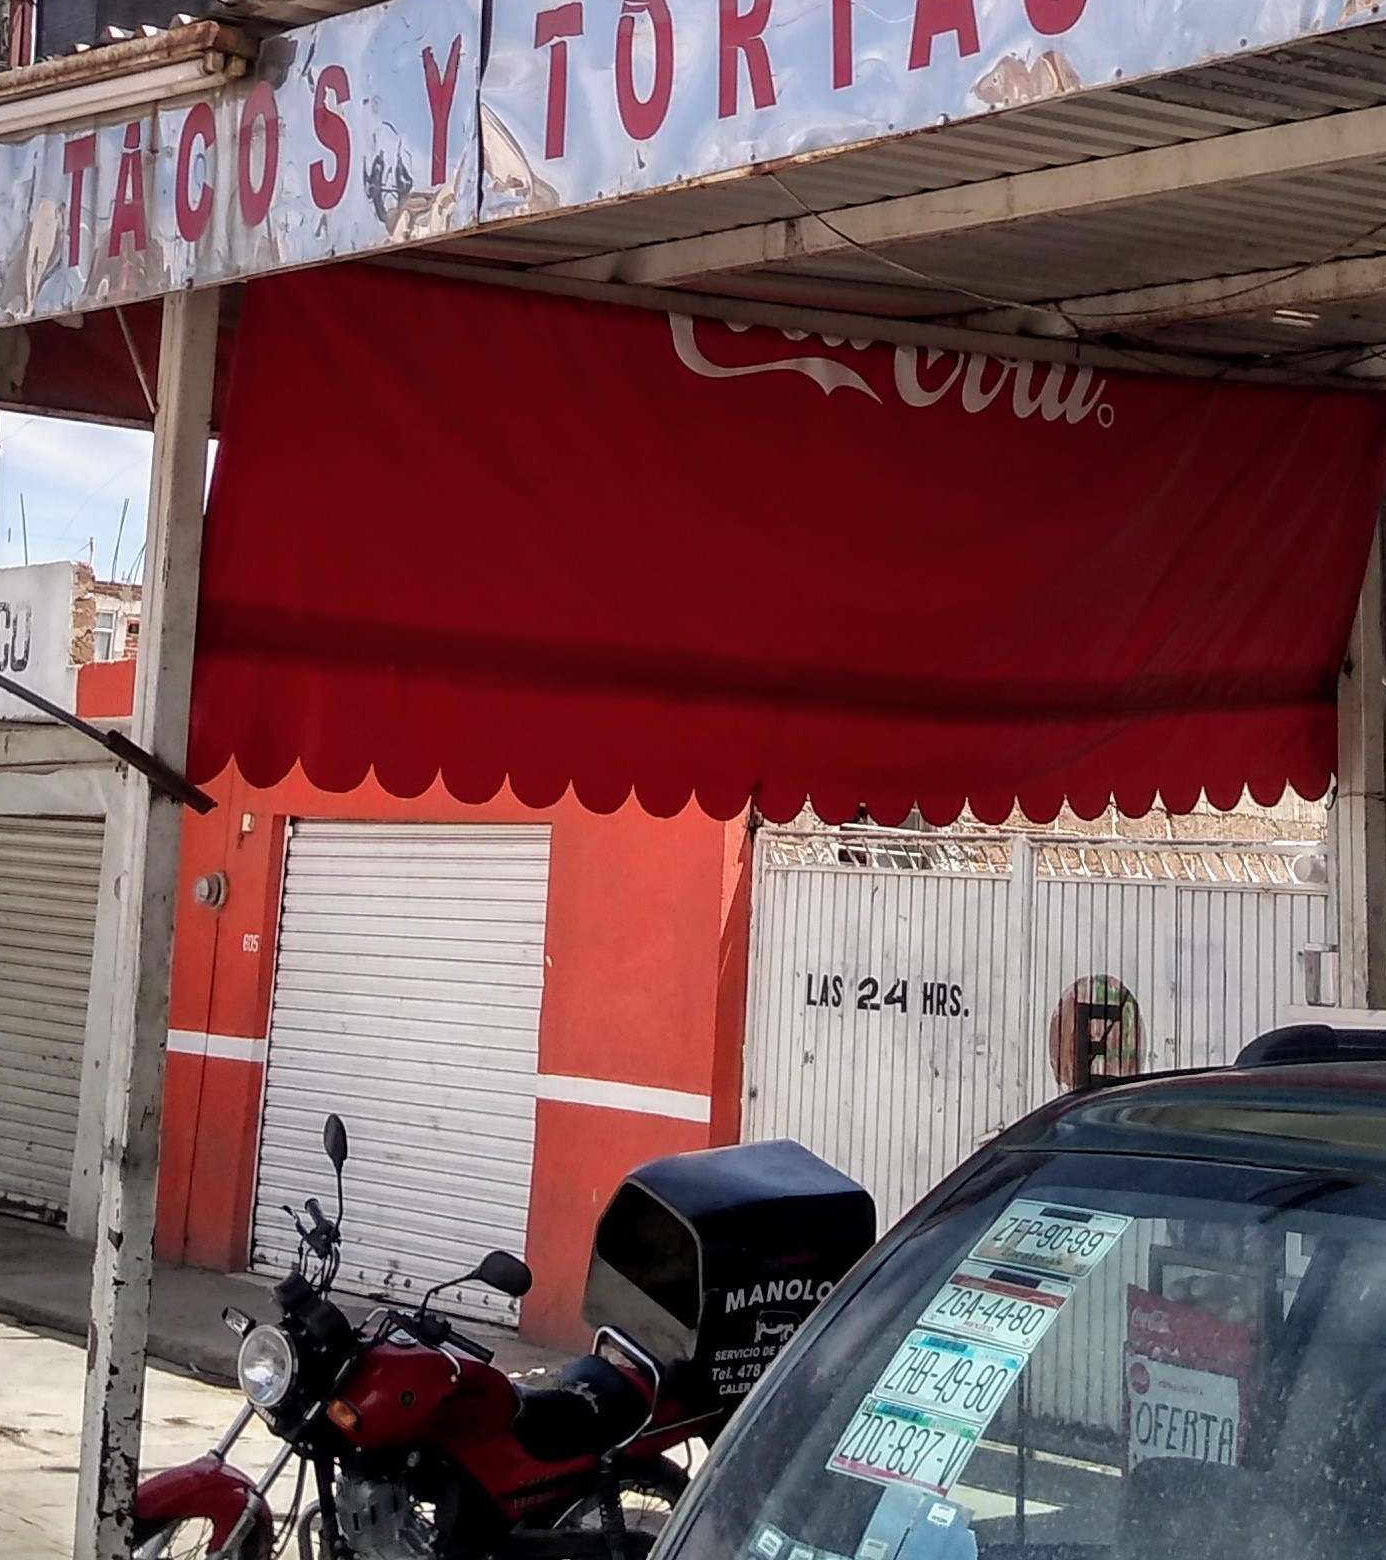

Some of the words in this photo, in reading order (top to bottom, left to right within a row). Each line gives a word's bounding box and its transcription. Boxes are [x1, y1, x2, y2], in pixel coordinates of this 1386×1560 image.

[63, 64, 351, 268] TACOS
[421, 34, 463, 187] Y
[806, 972, 844, 1009] LAS
[856, 976, 908, 1013] 24
[921, 981, 971, 1019] HRS.
[993, 1217, 1105, 1257] ZFP-90-99
[936, 1287, 1046, 1336] ZGA-44-80
[711, 1366, 734, 1381] Tel.
[737, 1363, 762, 1379] 478
[714, 1346, 761, 1362] SERVICIO
[762, 1345, 777, 1357] DE
[883, 1346, 1009, 1413] ZHB-49-80
[839, 1412, 971, 1487] ZDC-837-V
[1135, 1400, 1235, 1468] OFERTA
